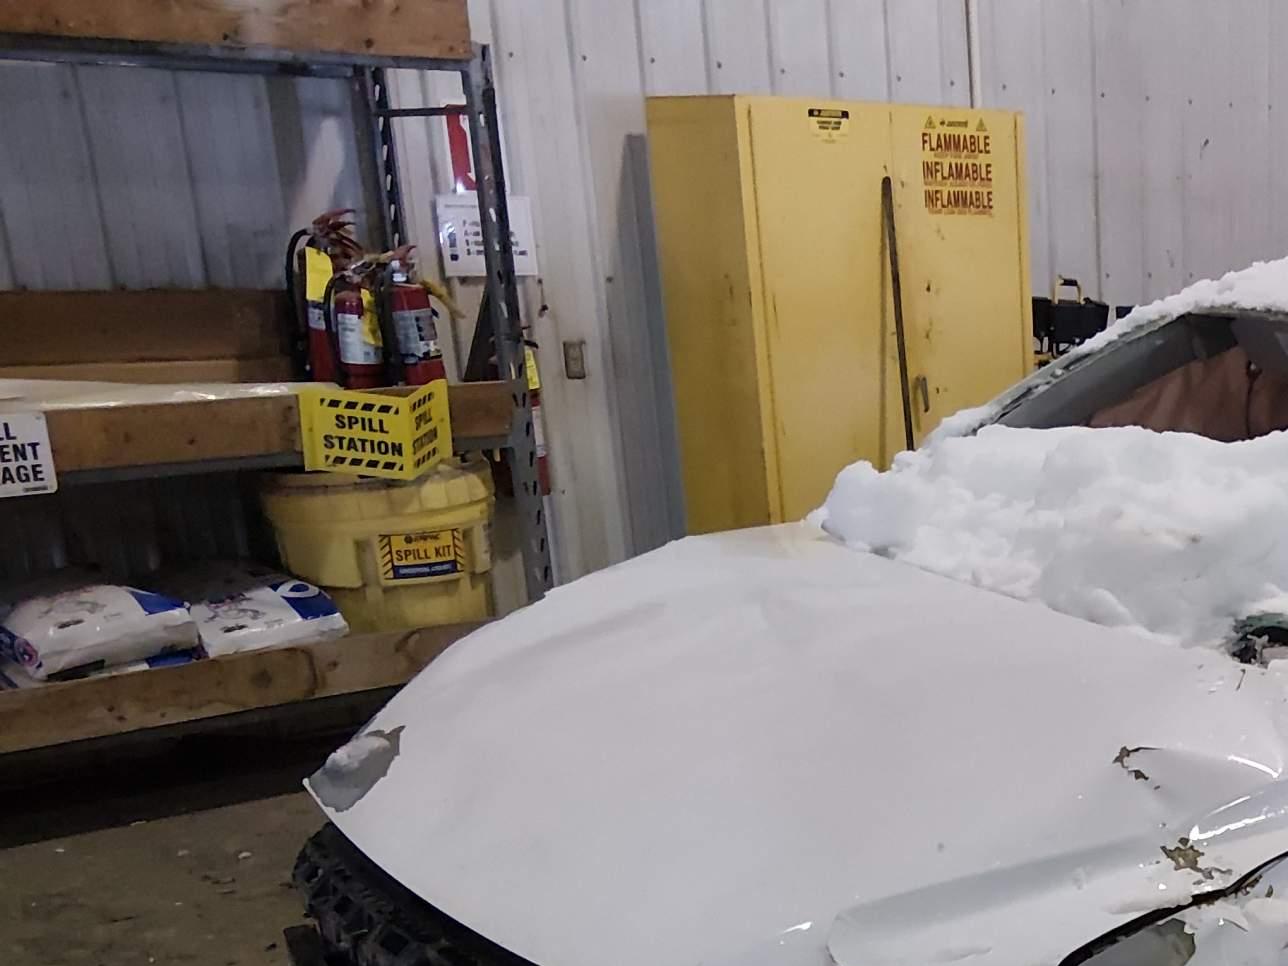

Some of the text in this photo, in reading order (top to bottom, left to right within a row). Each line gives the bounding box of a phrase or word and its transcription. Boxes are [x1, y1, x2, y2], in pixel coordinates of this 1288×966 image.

[921, 132, 991, 154] FLAMMABLE
[922, 160, 992, 182] INFLAMABLE
[924, 189, 994, 209] INFLAMMABLE
[336, 415, 389, 433] SPILL
[415, 407, 433, 431] SPILL
[323, 435, 403, 456] STATION
[2, 464, 45, 484] AGE
[396, 545, 451, 561] SPILL KIT
